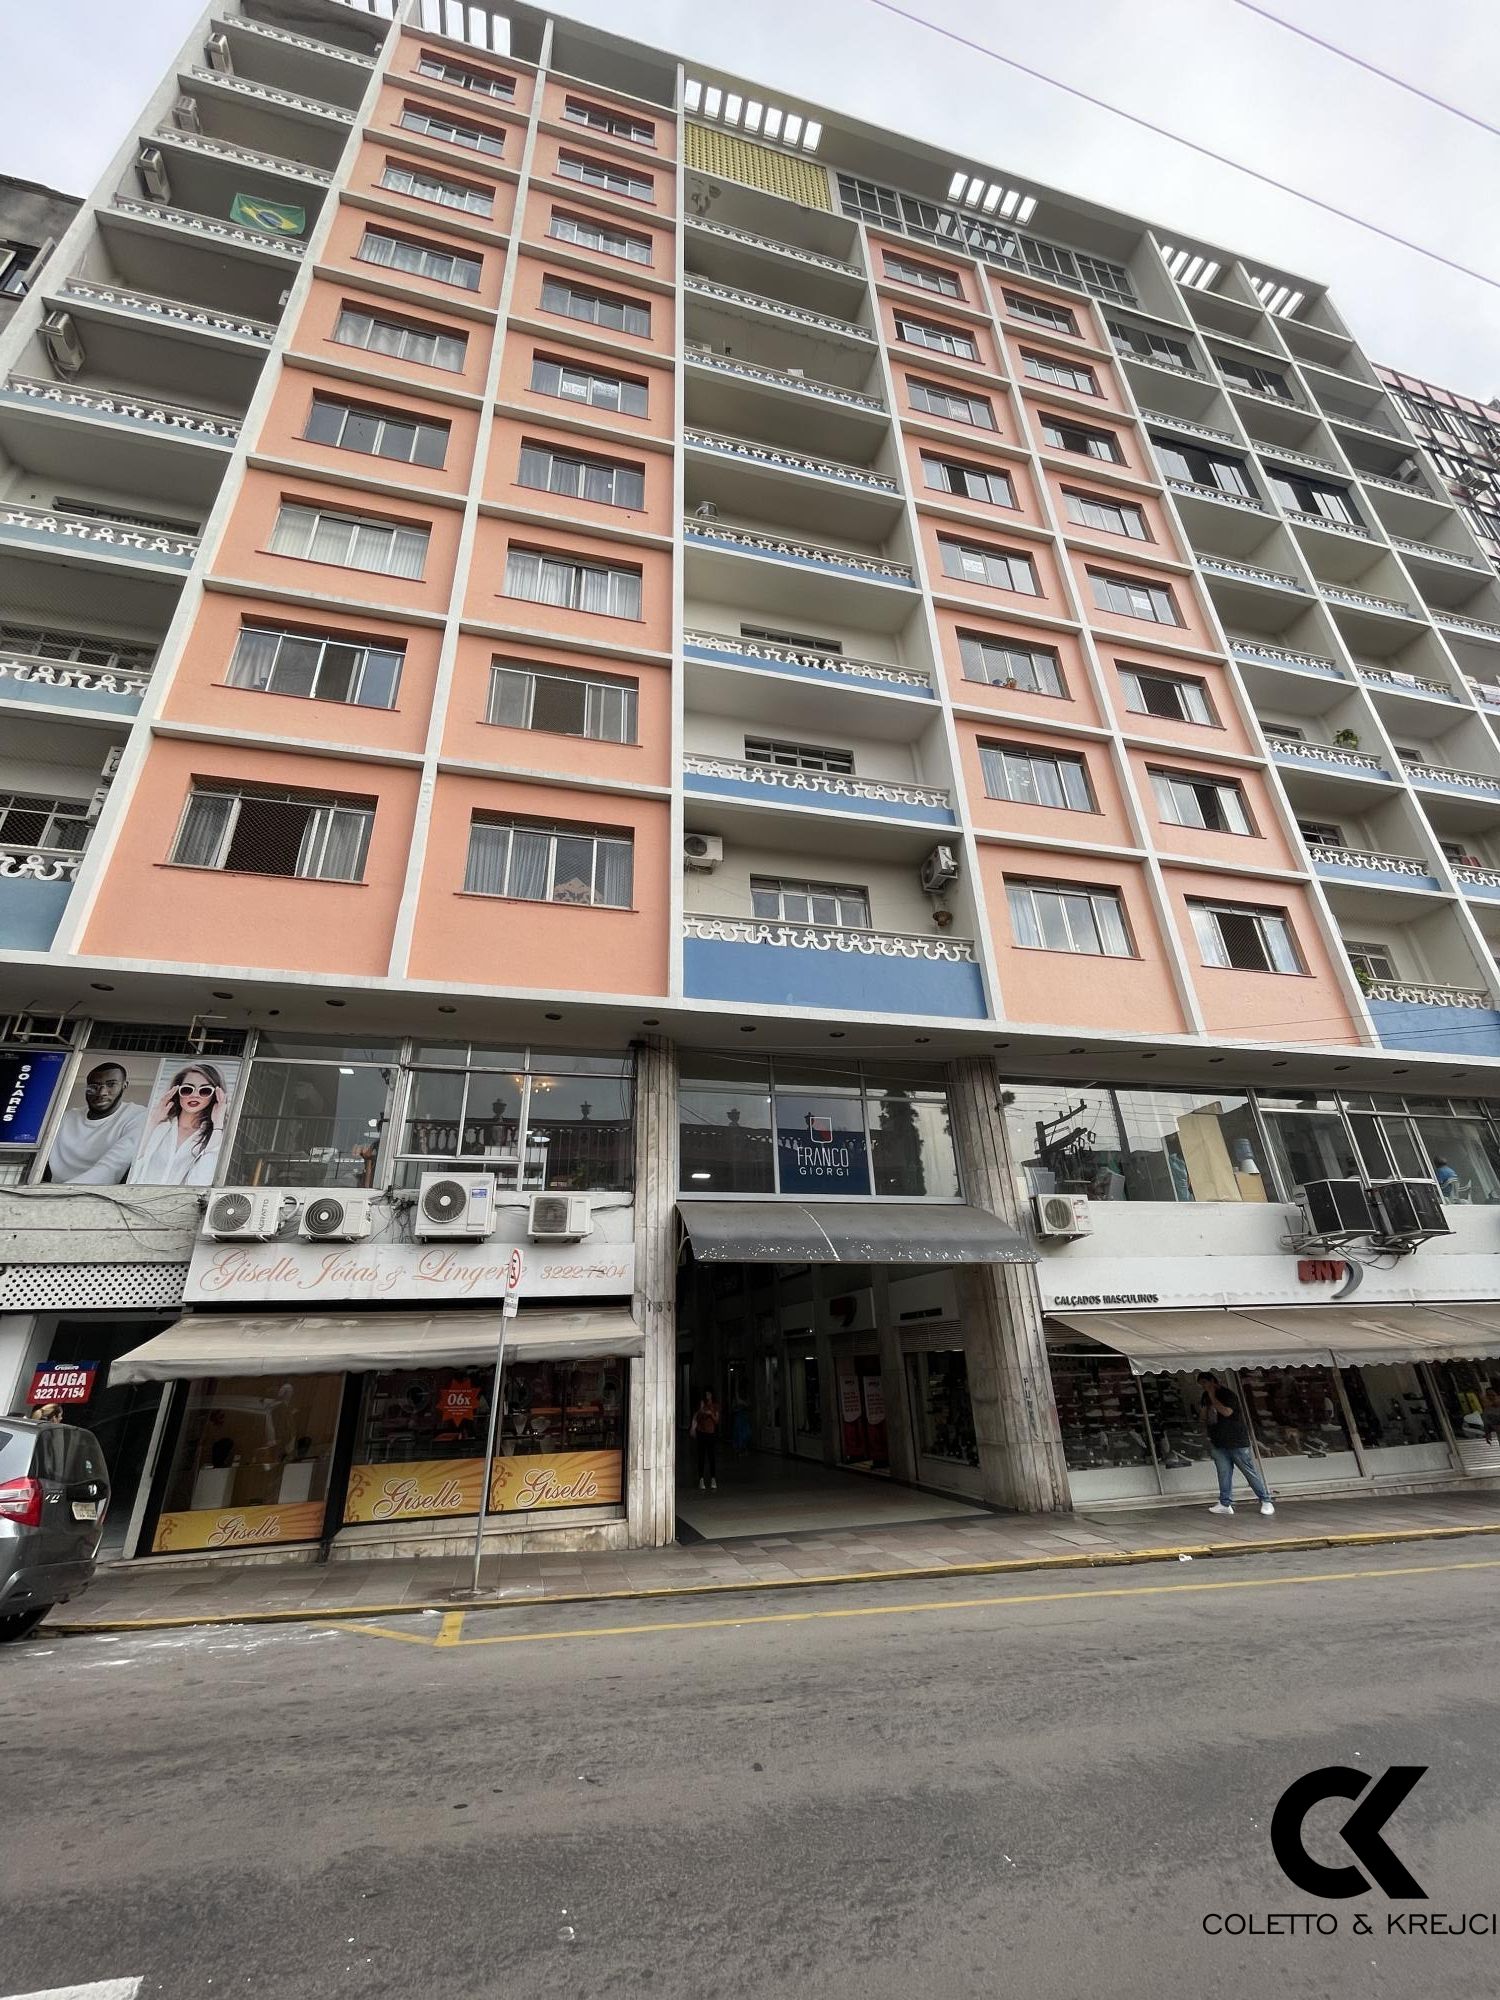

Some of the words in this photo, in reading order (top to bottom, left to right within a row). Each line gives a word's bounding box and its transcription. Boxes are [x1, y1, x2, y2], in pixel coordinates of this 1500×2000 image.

[3, 1065, 31, 1121] SOLARES
[797, 1147, 849, 1167] FRANCO
[799, 1166, 849, 1177] GIORGI
[199, 1247, 300, 1292] Giselle
[297, 1249, 379, 1290] Jóias
[378, 1265, 407, 1292] &
[1054, 1295, 1101, 1307] CALÇADOS
[1102, 1293, 1159, 1305] MASCULINOS
[38, 1372, 87, 1387] ALUGA
[33, 1387, 85, 1400] 3221.7154
[447, 1393, 471, 1406] 06x
[372, 1477, 462, 1518] Giselle
[515, 1469, 598, 1508] Giselle
[207, 1515, 280, 1548] Giselle
